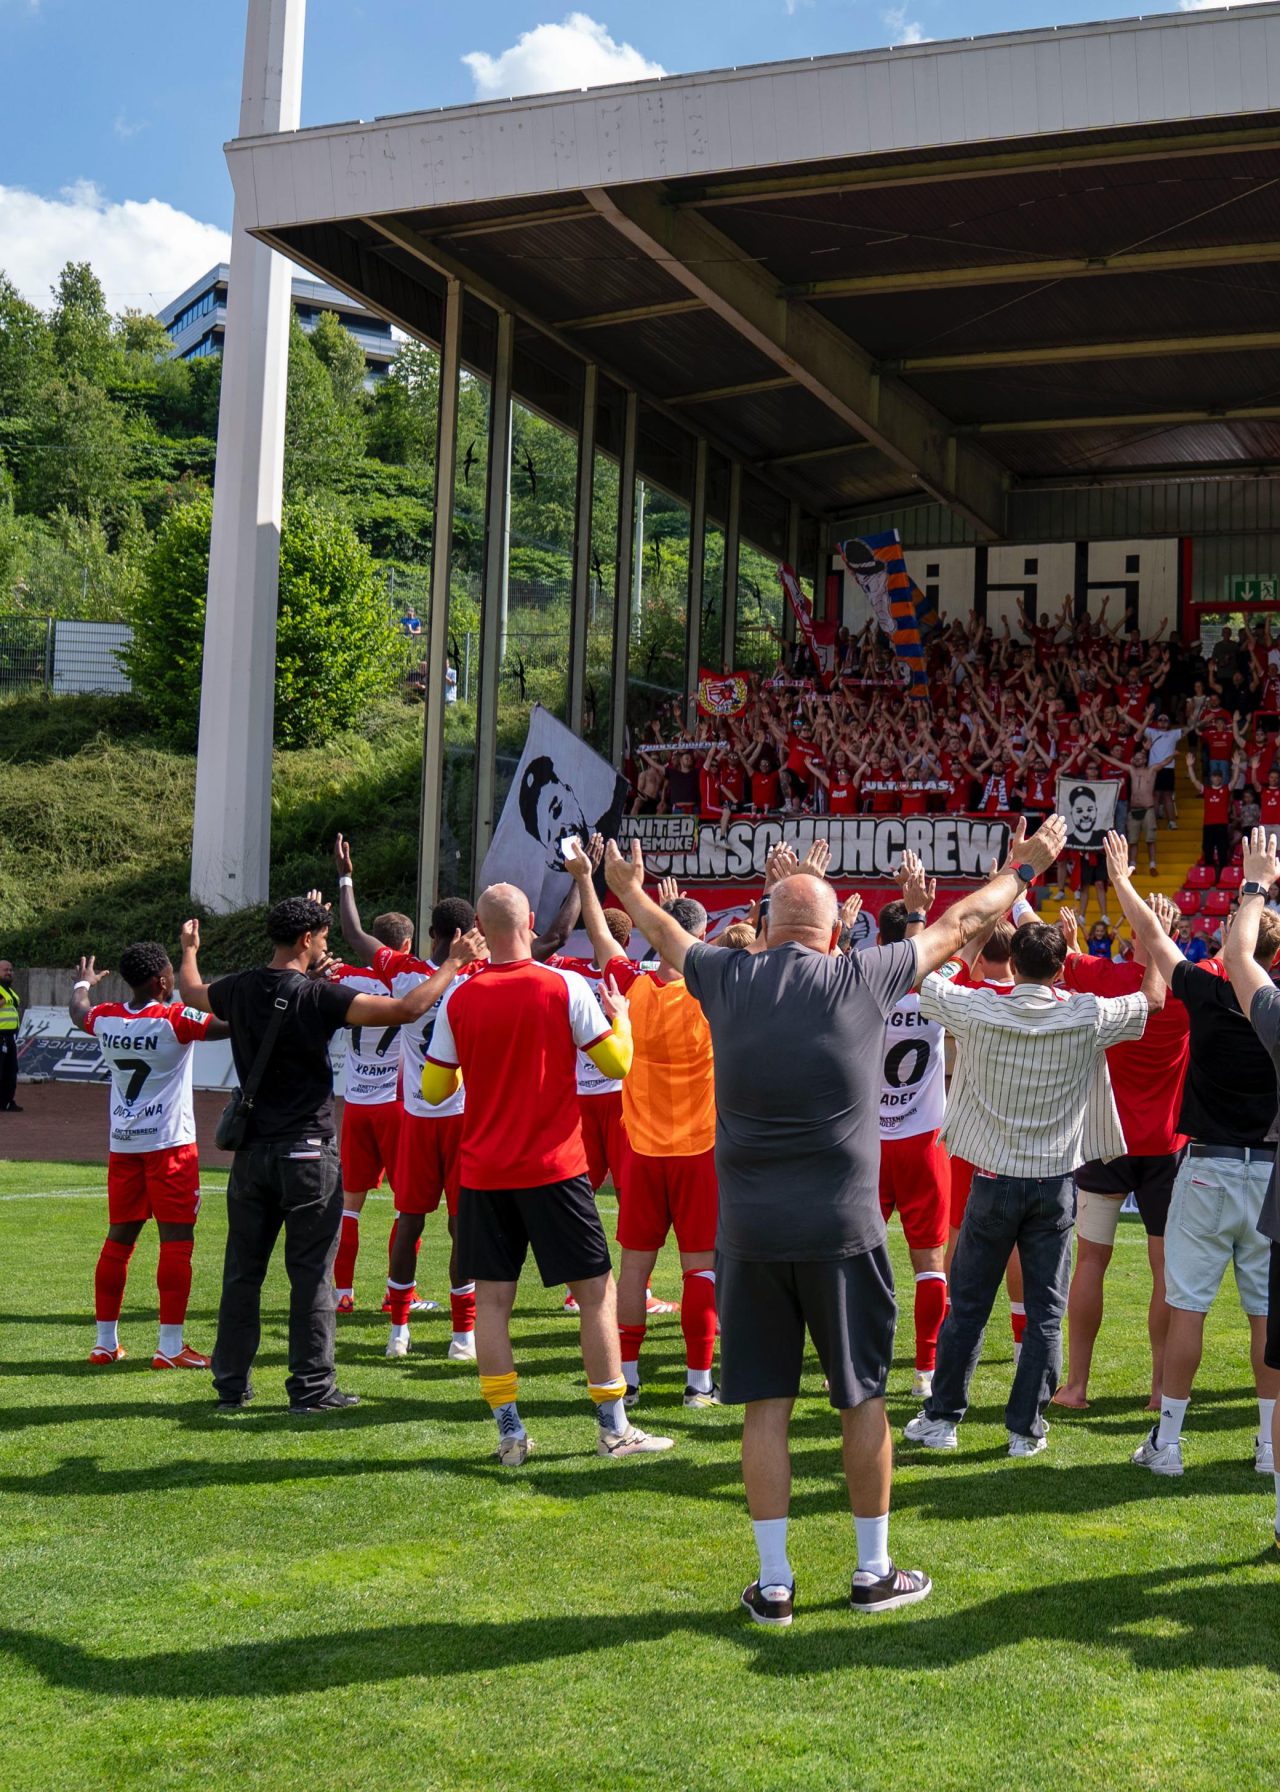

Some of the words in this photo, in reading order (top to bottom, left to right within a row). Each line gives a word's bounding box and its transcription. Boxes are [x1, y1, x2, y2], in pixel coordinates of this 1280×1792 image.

[642, 837, 693, 851] SMOKE
[885, 1012, 929, 1027] GEN
[102, 1031, 159, 1051] SIEGEN
[113, 1059, 152, 1107] 7
